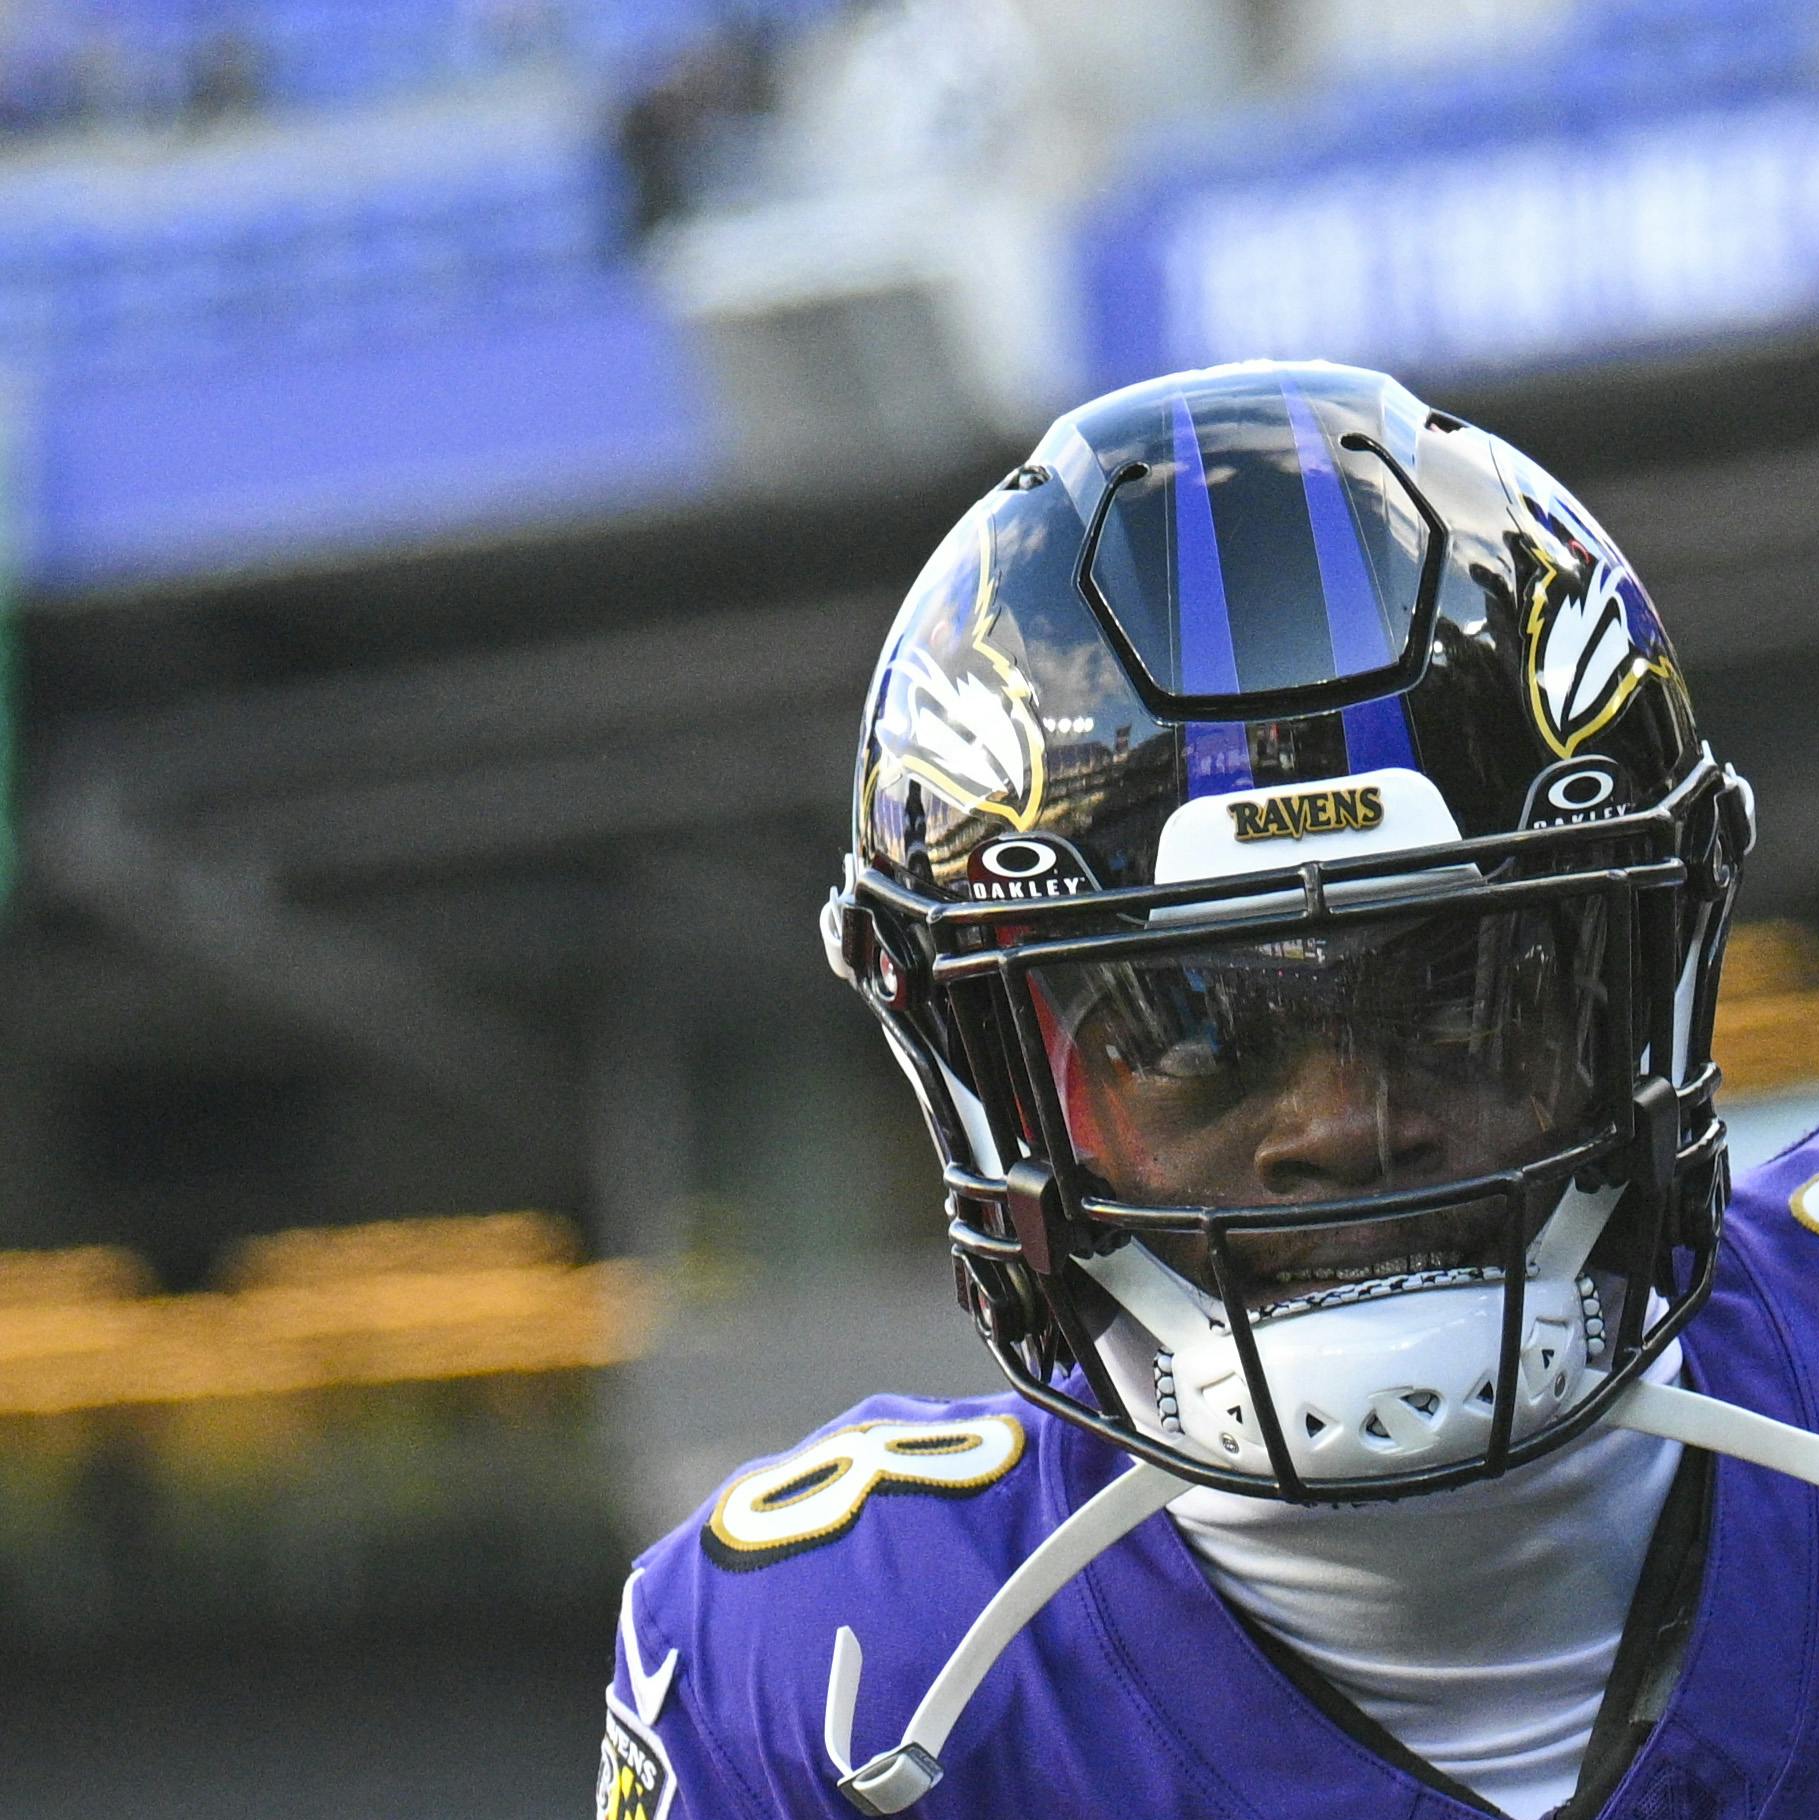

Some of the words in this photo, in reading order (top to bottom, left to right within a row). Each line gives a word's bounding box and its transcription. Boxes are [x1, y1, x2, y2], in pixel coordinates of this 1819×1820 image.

[1227, 786, 1384, 843] RAVENS
[1533, 802, 1628, 830] OAKLEY
[972, 876, 1080, 900] OAKLEY
[701, 1414, 1026, 1574] 8
[605, 1710, 657, 1791] VENS
